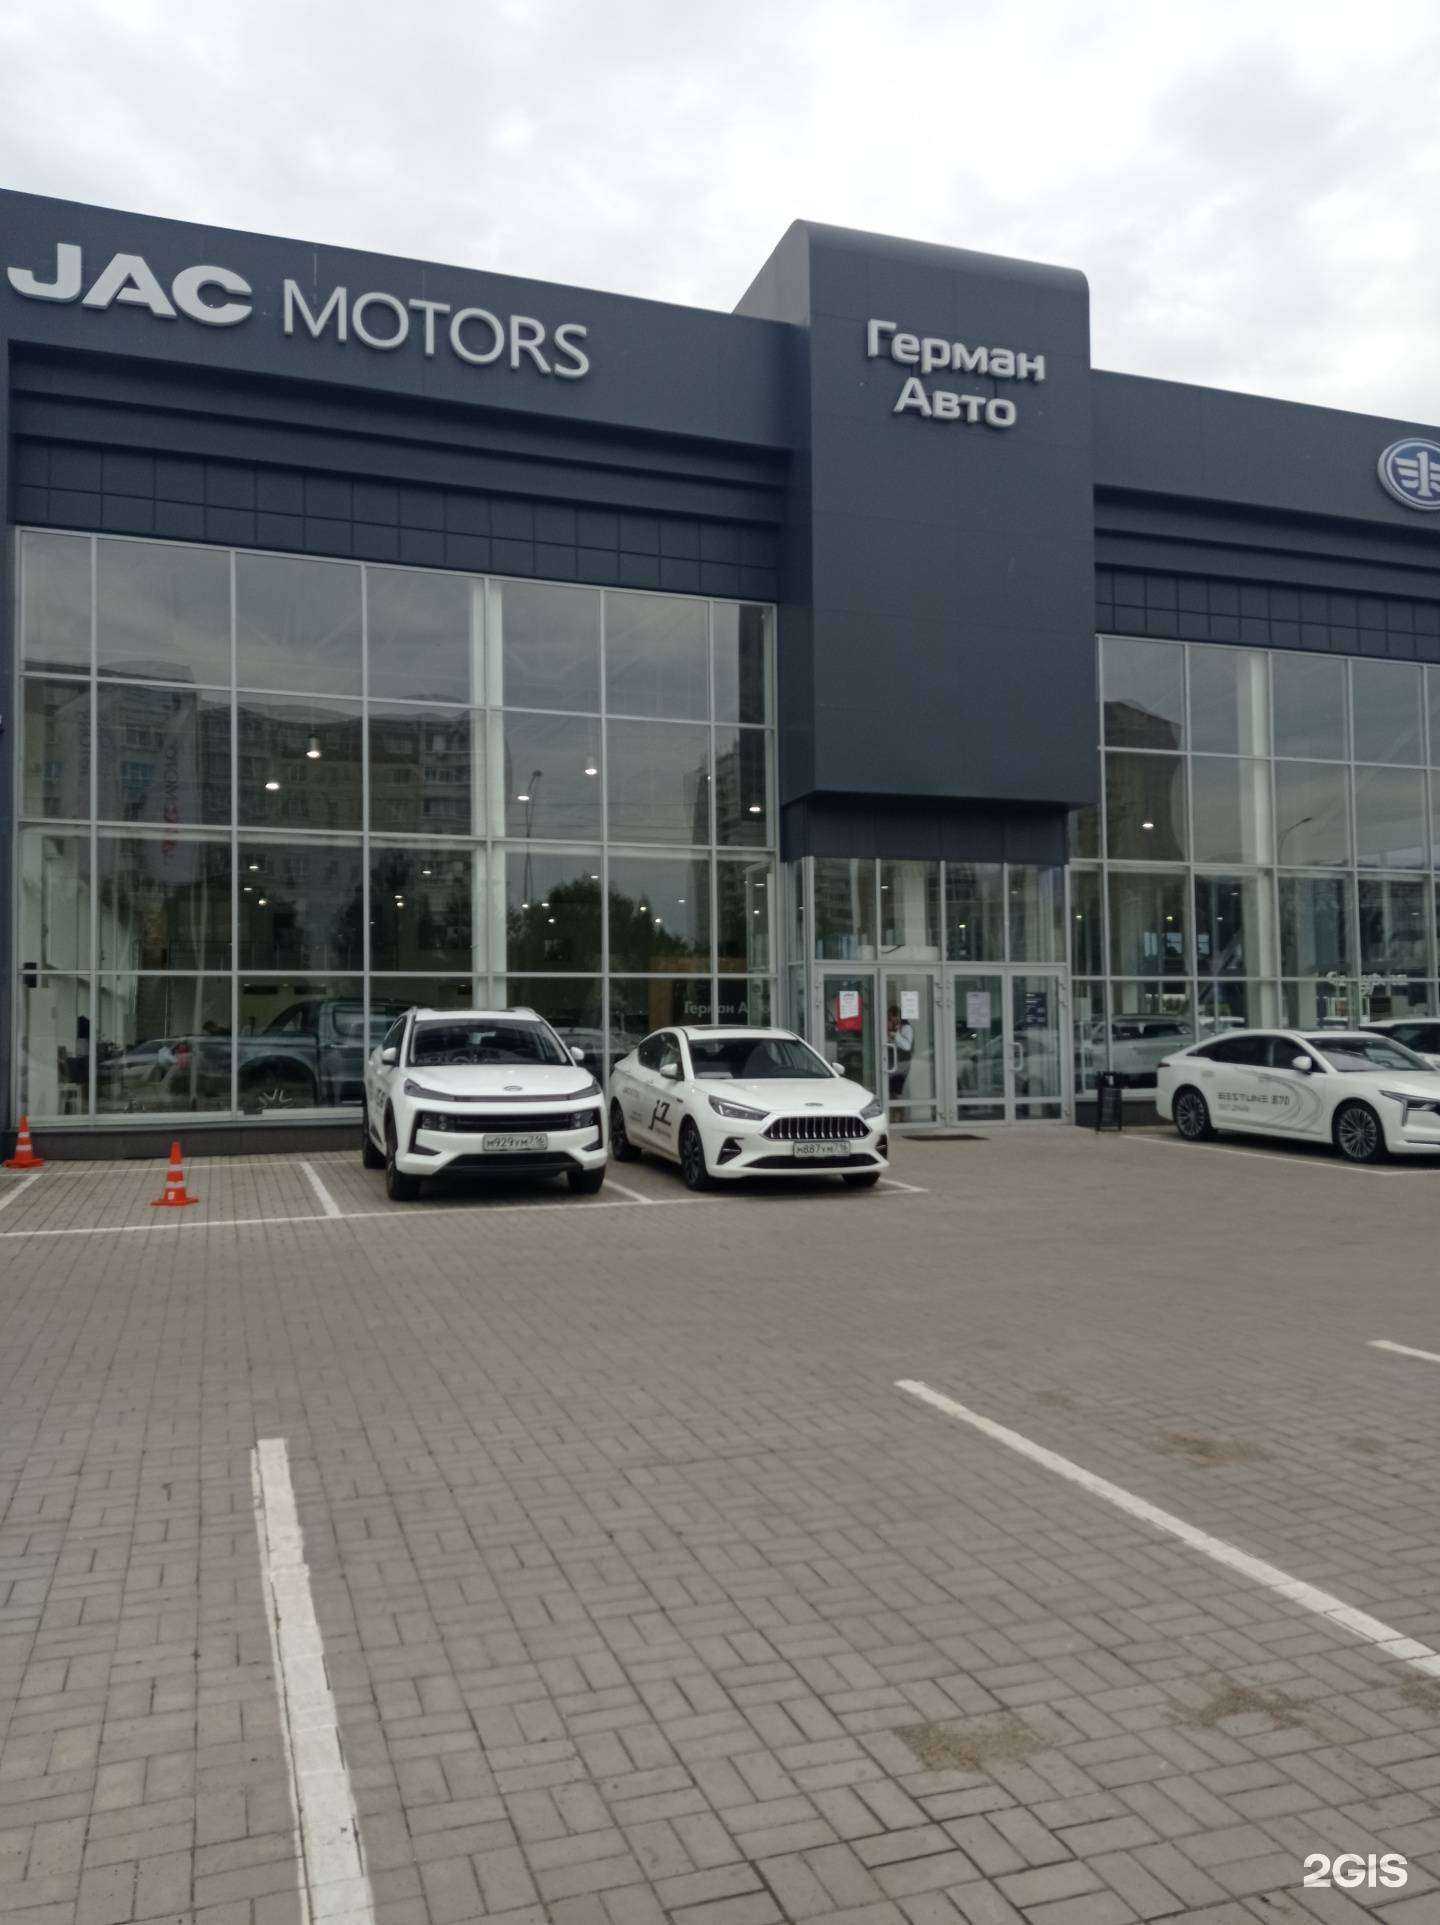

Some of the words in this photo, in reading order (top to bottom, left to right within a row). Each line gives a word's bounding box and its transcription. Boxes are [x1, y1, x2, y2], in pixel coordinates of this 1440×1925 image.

[7, 242, 253, 327] JAC
[282, 278, 590, 380] MOTORS
[866, 318, 1046, 382] Герман
[893, 376, 1017, 428] Авто
